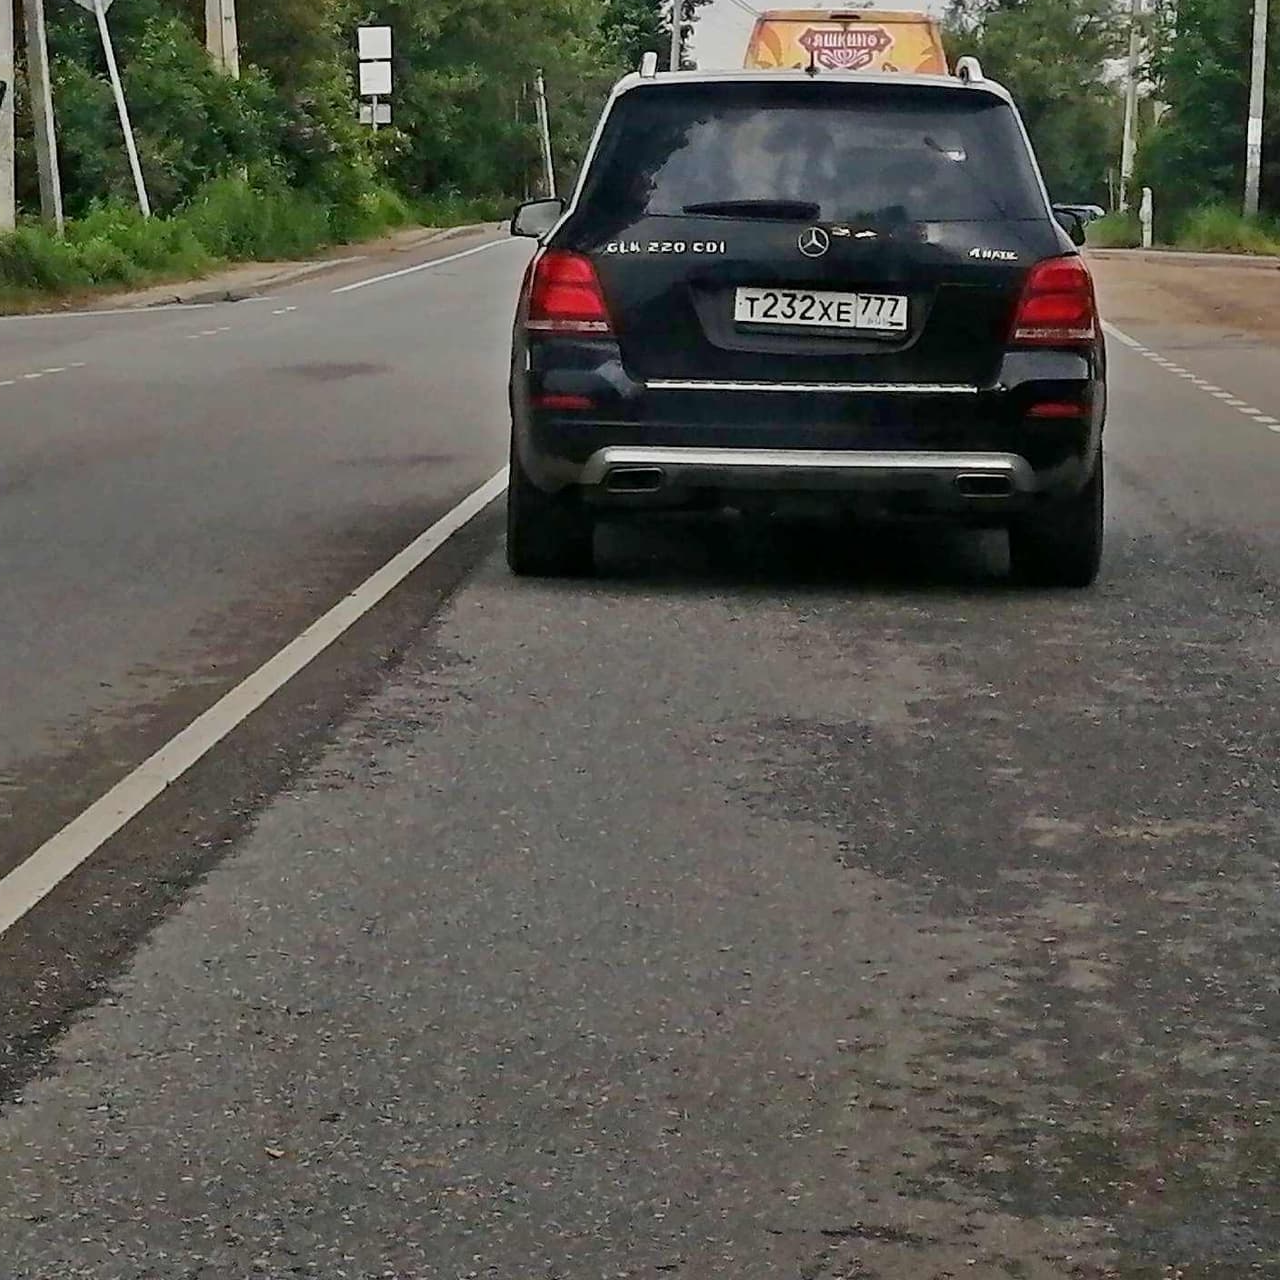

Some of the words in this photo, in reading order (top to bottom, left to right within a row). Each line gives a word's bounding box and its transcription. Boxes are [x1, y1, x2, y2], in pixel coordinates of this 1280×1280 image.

[606, 240, 640, 254] GLK
[647, 241, 686, 254] 220
[692, 241, 726, 254] CDI
[859, 295, 900, 318] 777
